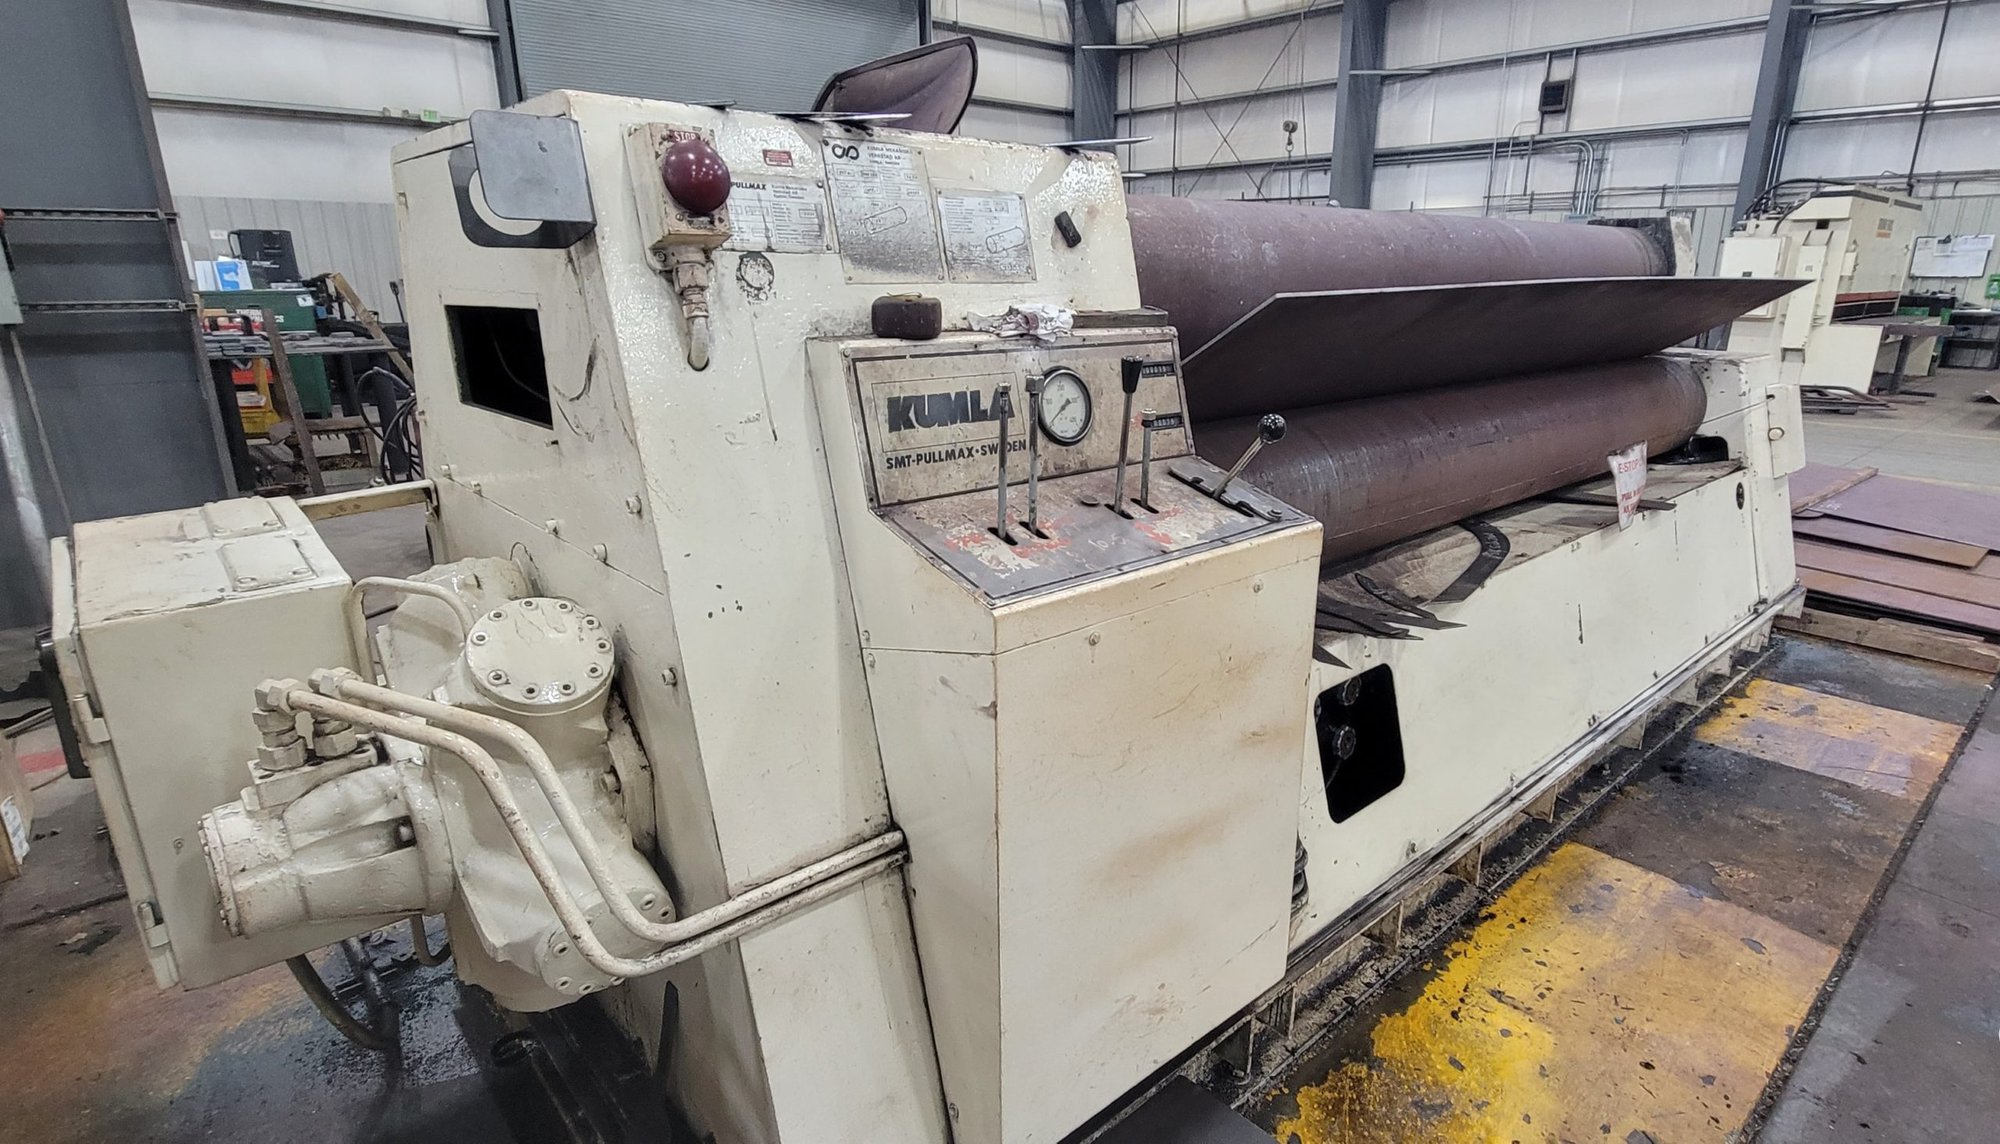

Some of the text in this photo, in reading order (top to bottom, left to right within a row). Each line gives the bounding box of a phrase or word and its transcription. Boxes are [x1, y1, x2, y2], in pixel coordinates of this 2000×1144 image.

[674, 131, 696, 141] STOP
[730, 181, 767, 191] PULLMAX
[887, 386, 1016, 434] KUMLA
[980, 439, 1027, 457] SWDEN
